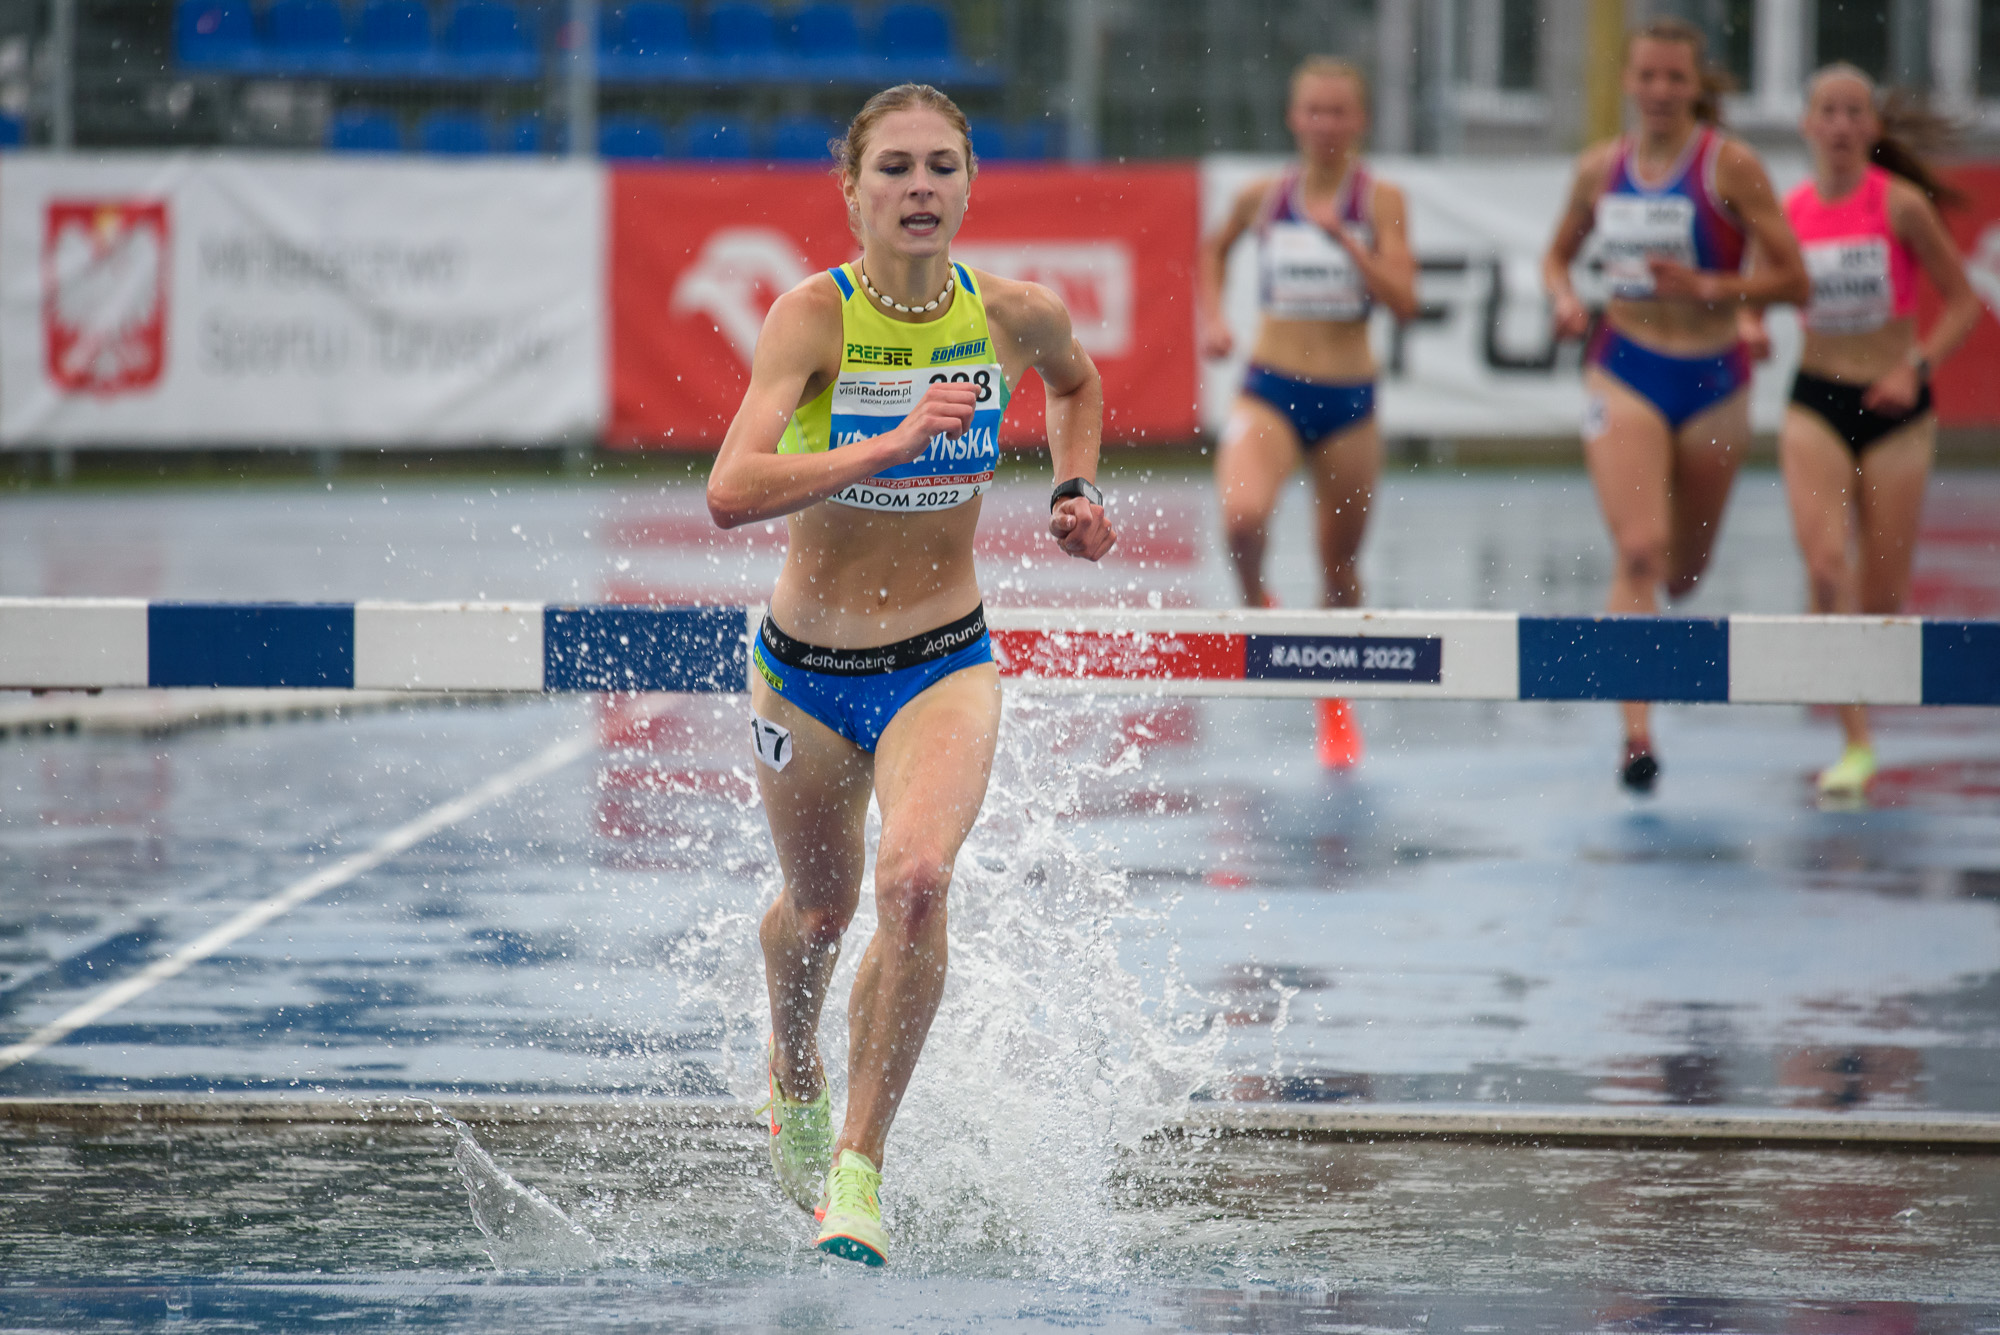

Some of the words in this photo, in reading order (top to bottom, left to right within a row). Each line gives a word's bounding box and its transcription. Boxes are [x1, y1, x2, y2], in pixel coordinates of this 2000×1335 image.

[930, 340, 987, 363] SONAROL
[839, 385, 912, 399] visitRadom.pl
[933, 475, 970, 486] POLSKI
[971, 472, 990, 484] U20
[915, 490, 960, 507] 2022
[1271, 644, 1359, 668] RADOM
[1361, 645, 1417, 670] 2022
[751, 718, 789, 763] 17
